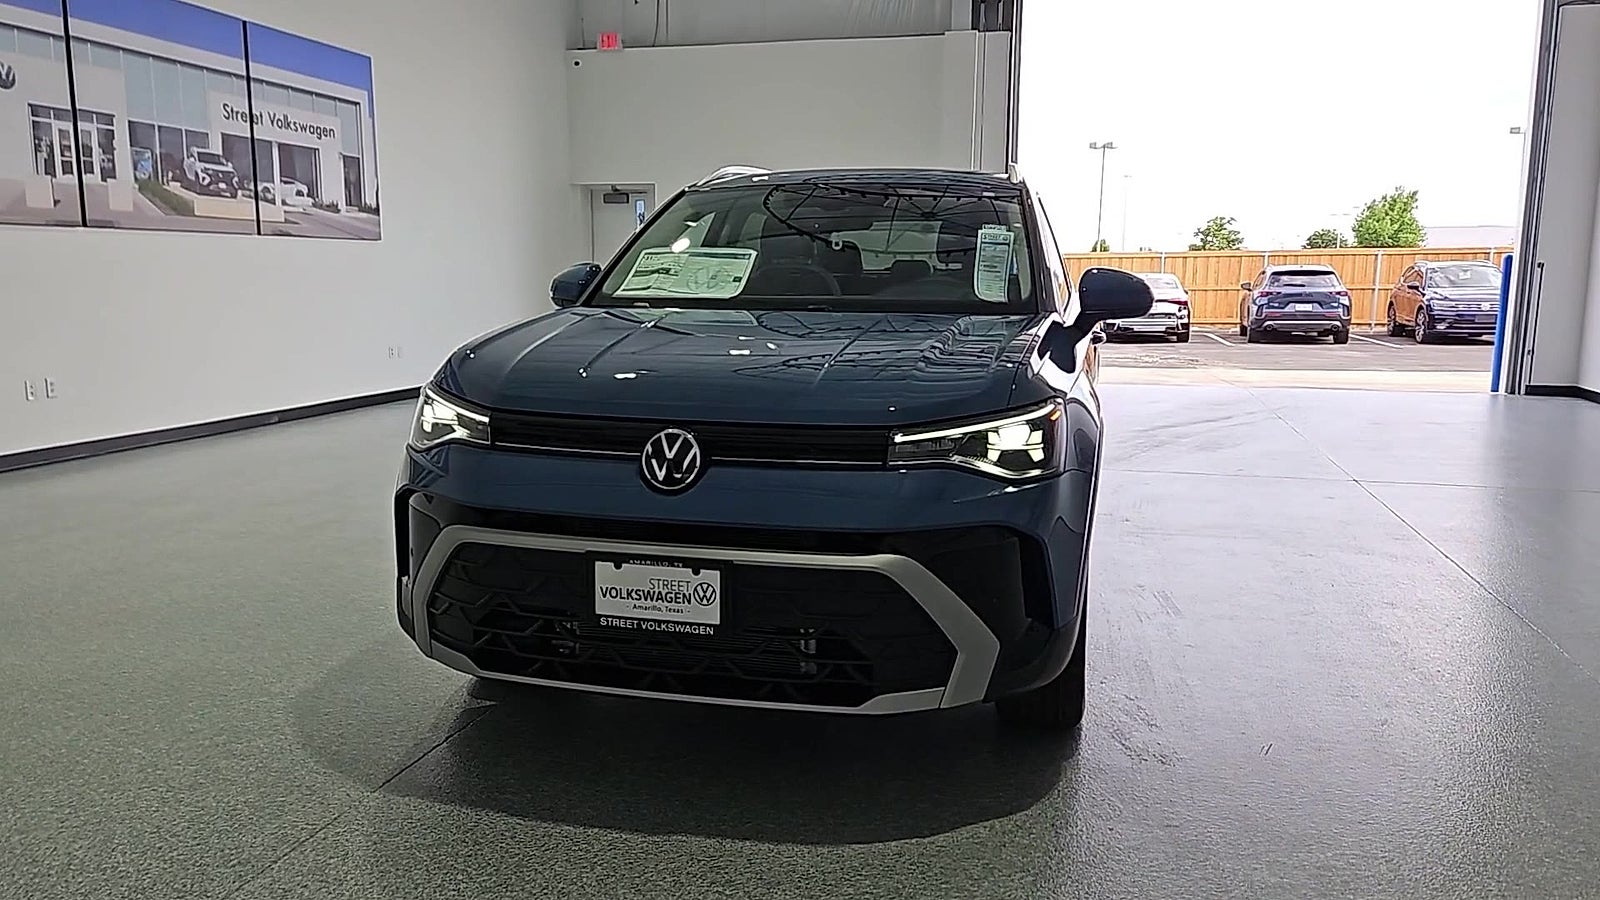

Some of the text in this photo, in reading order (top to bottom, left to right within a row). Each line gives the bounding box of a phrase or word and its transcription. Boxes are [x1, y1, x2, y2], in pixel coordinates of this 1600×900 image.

[222, 102, 336, 140] Street Volkswagen
[648, 578, 692, 593] STREET
[599, 586, 692, 606] VOLKSWAGEN
[632, 603, 664, 613] Amarillo,
[665, 606, 684, 614] Texas
[600, 617, 714, 635] STREET VOLKSWAGEN
